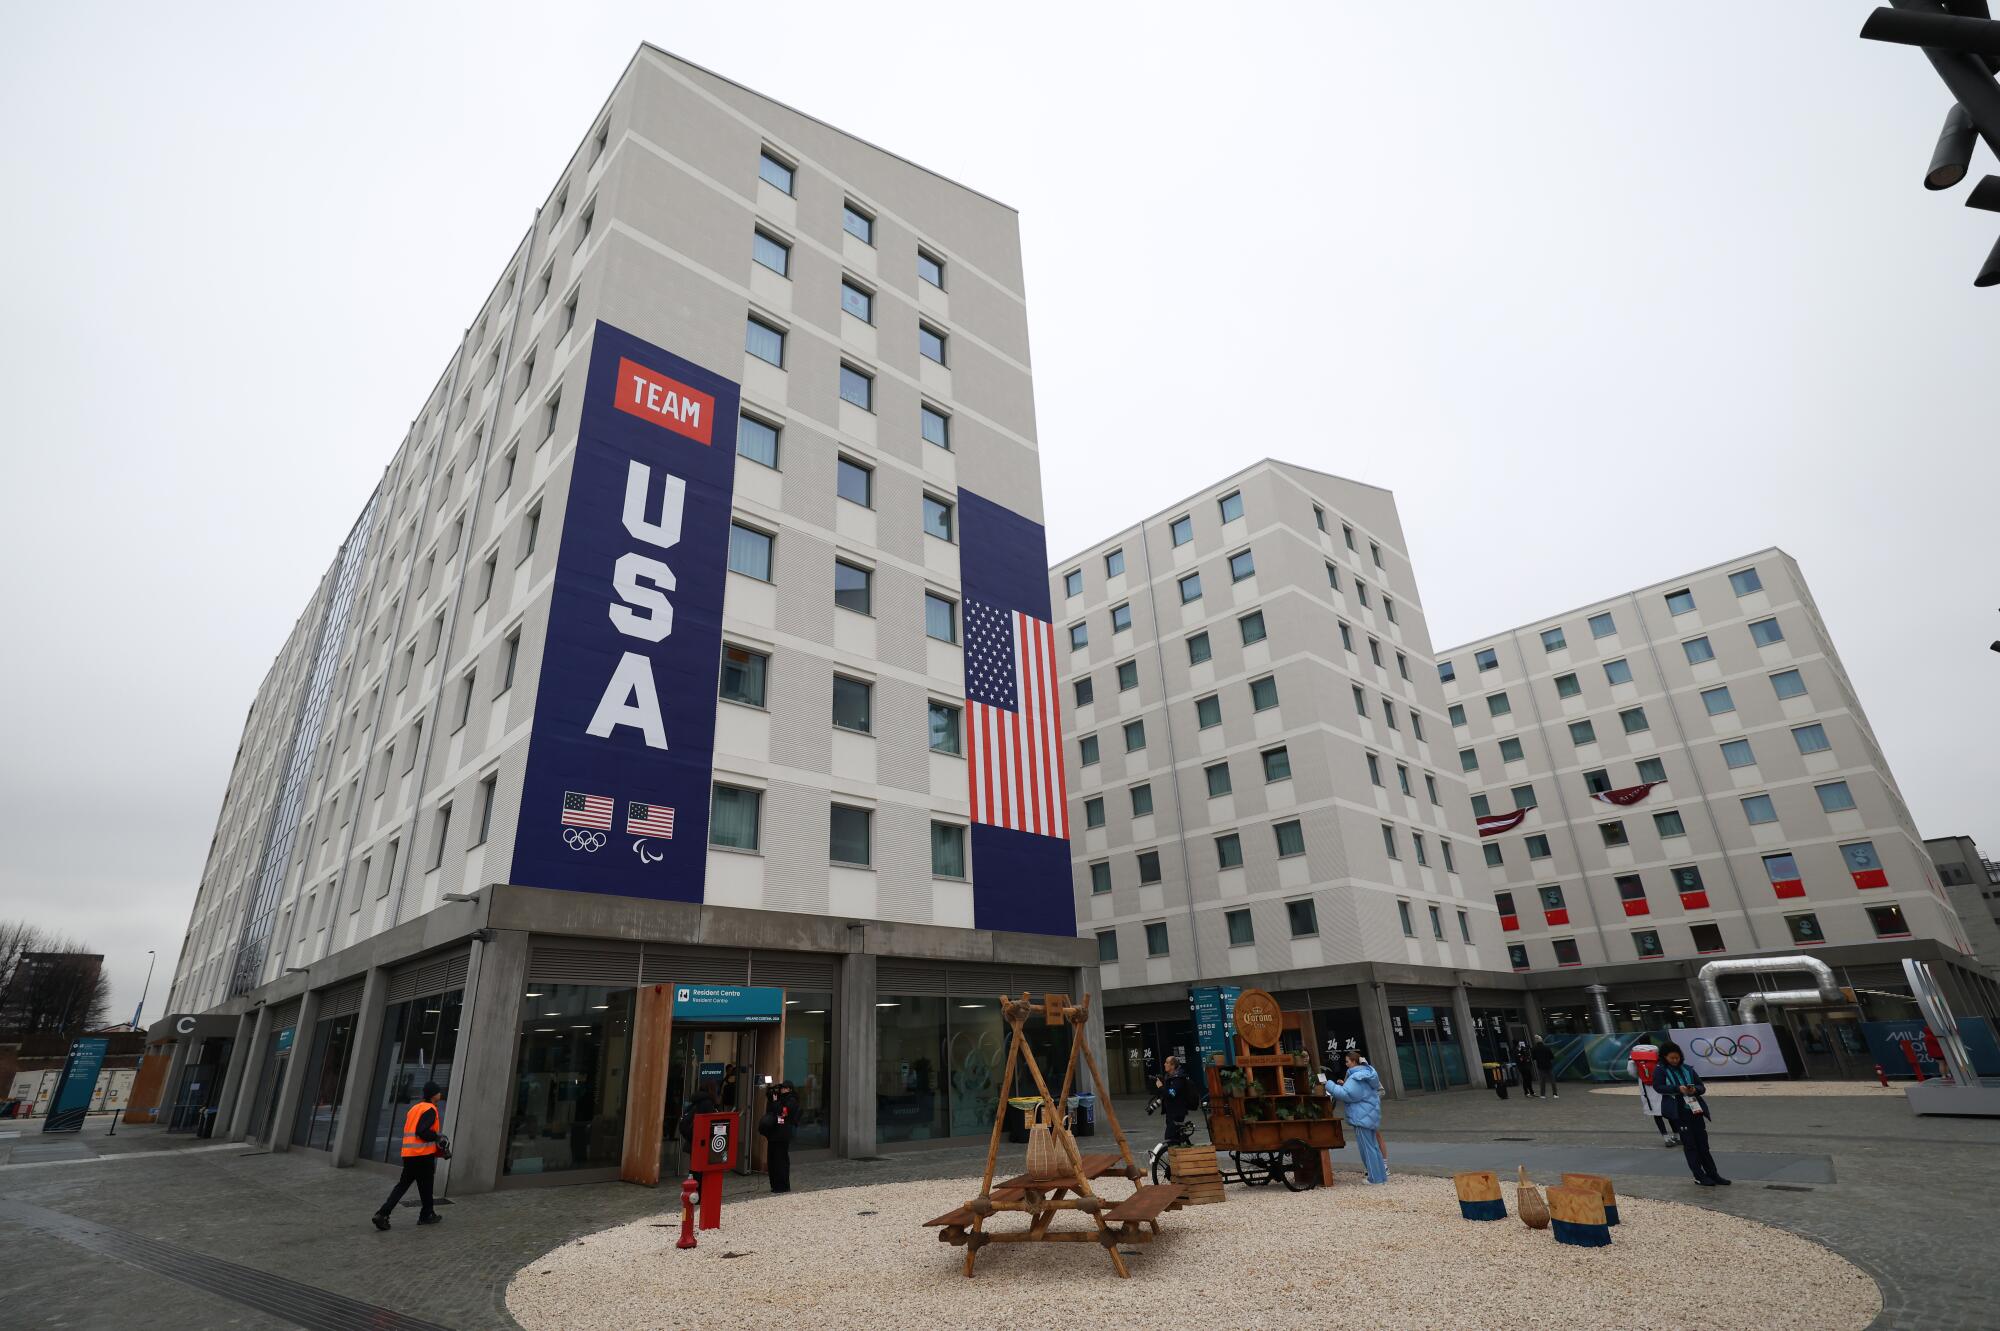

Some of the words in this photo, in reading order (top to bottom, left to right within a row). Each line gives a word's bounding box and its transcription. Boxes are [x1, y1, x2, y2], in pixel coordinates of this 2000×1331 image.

[633, 375, 701, 428] TEAM
[585, 459, 686, 750] USA
[692, 989, 720, 997] Resident
[720, 989, 741, 998] Centre
[176, 1016, 197, 1034] C
[1243, 1012, 1273, 1025] Corona
[1885, 1031, 1926, 1042] MILA
